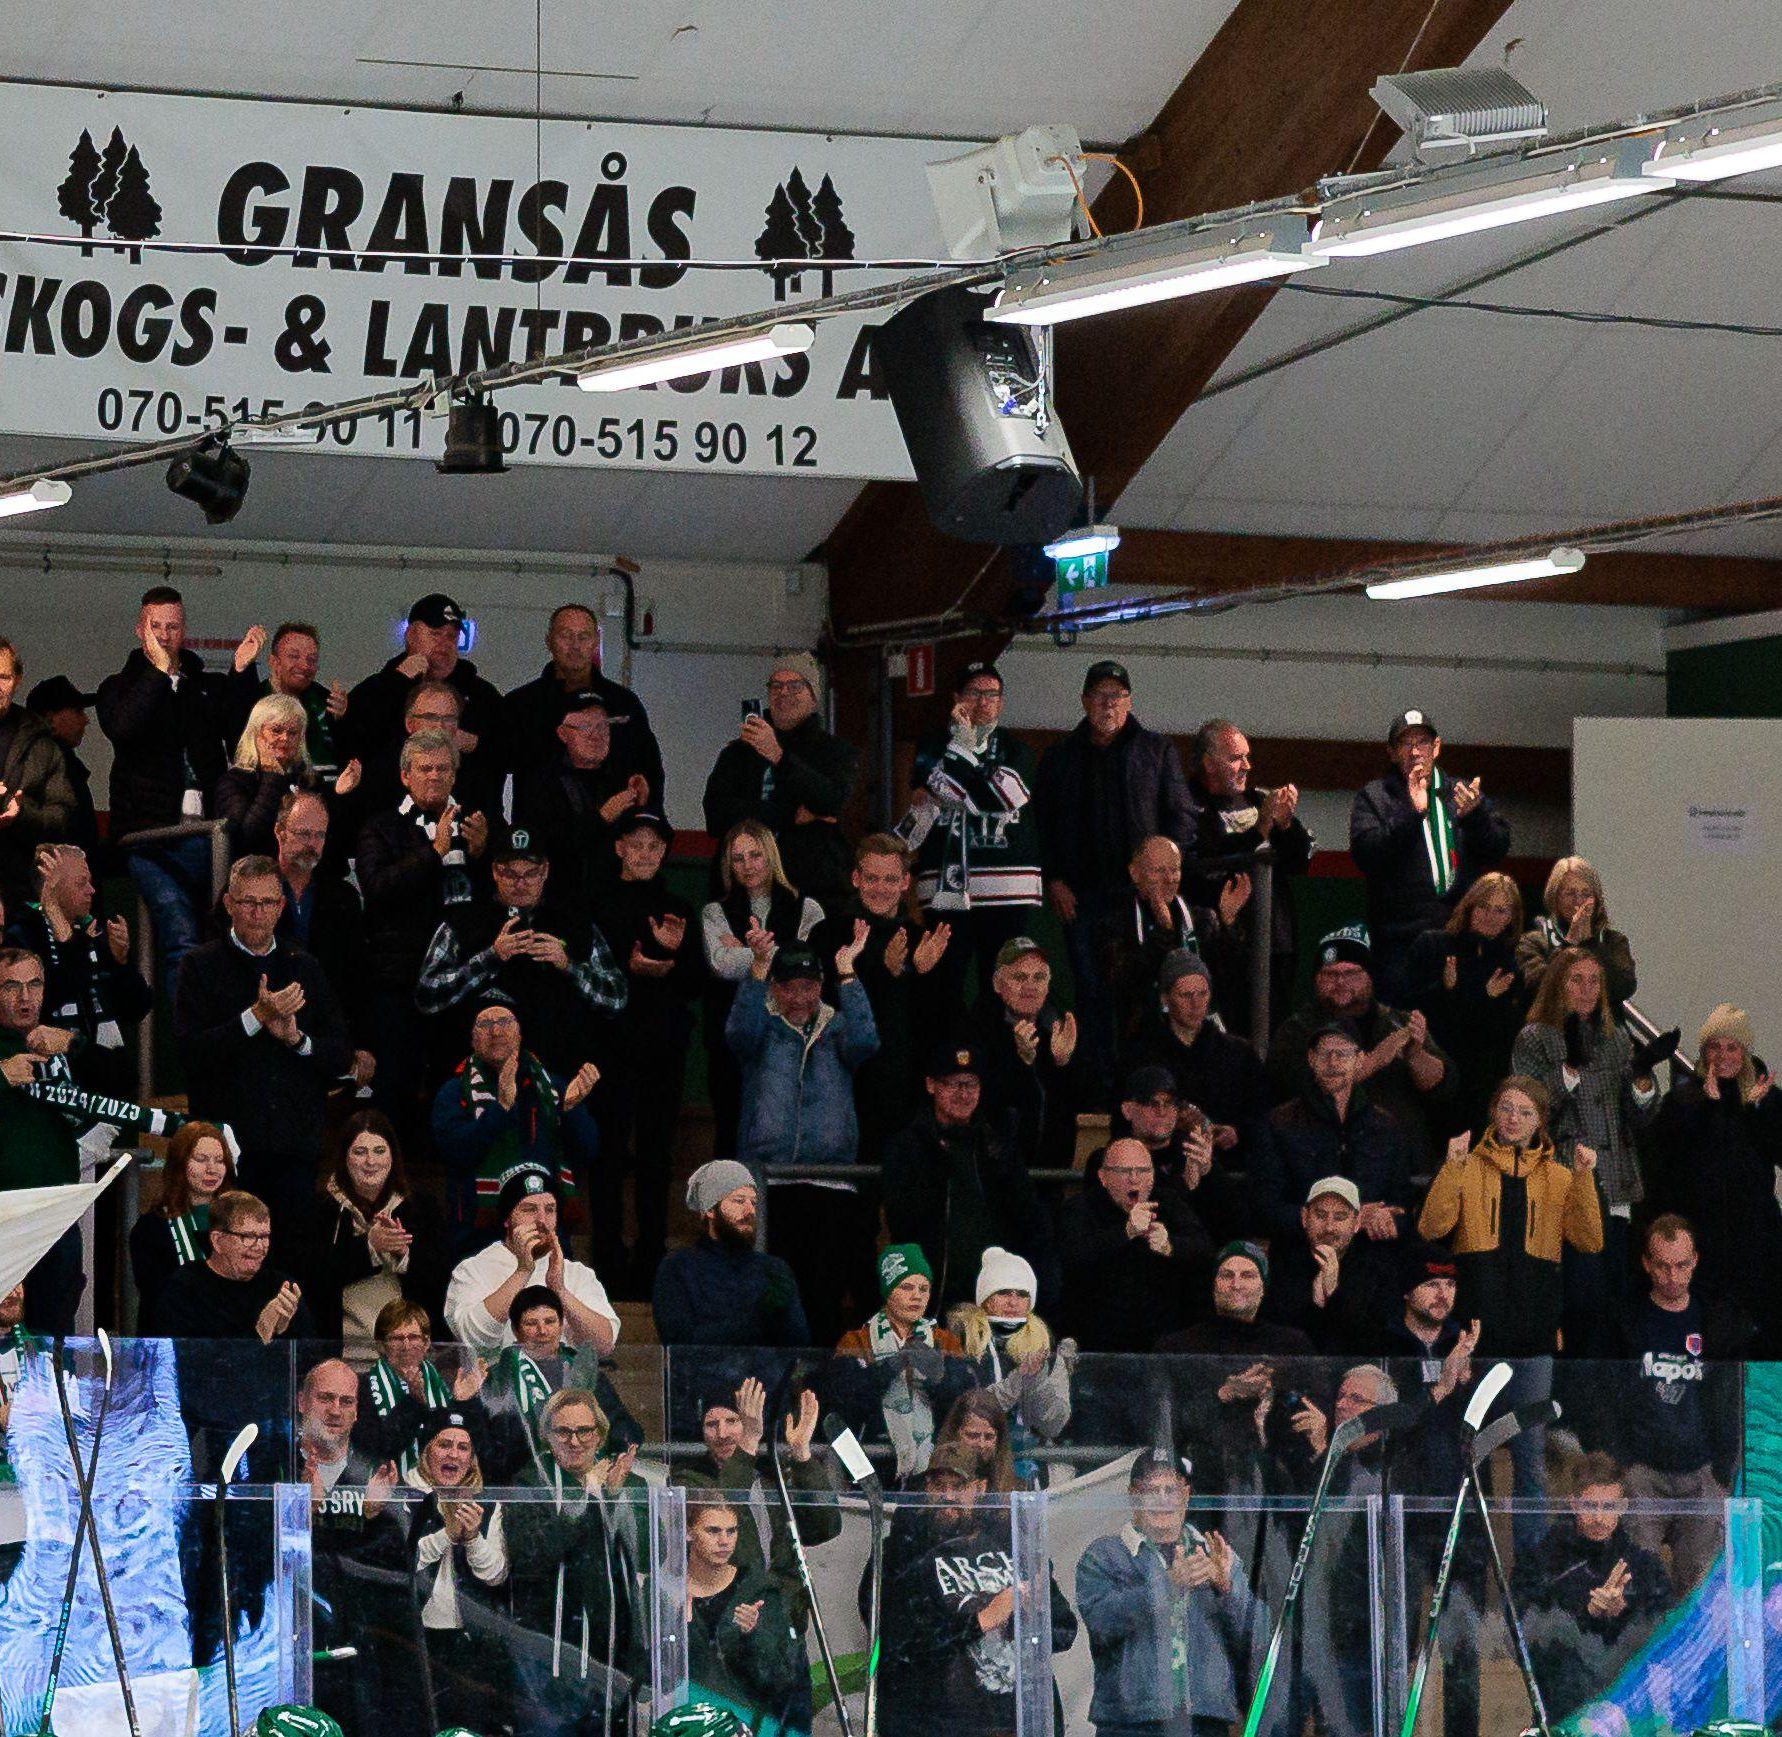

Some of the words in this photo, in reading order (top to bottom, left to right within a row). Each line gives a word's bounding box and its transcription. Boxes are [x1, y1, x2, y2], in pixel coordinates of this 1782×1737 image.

[217, 151, 697, 290] GRANSÅS
[274, 294, 333, 375] &
[498, 411, 679, 463] 070-515
[694, 420, 748, 464] 90
[766, 424, 818, 468] 12
[45, 1084, 141, 1121] 2024/2025
